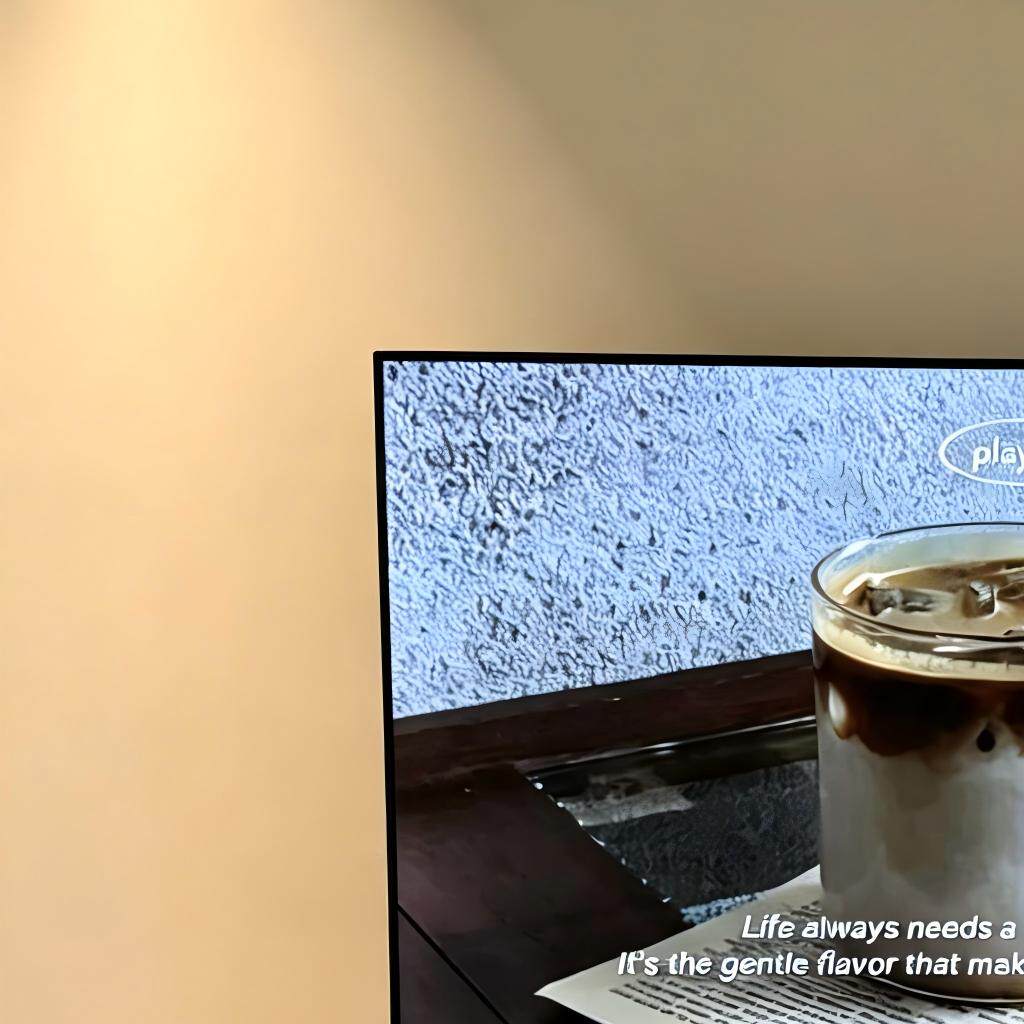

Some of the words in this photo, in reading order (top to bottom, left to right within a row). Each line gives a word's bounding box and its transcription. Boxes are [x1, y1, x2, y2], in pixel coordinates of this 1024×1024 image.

[741, 914, 795, 940] Life
[801, 915, 900, 945] always
[906, 915, 993, 941] needs
[999, 919, 1018, 940] a
[617, 950, 659, 976] It's
[668, 951, 713, 976] the
[719, 950, 810, 983] gentle
[816, 949, 900, 977] flavor
[905, 951, 962, 977] that
